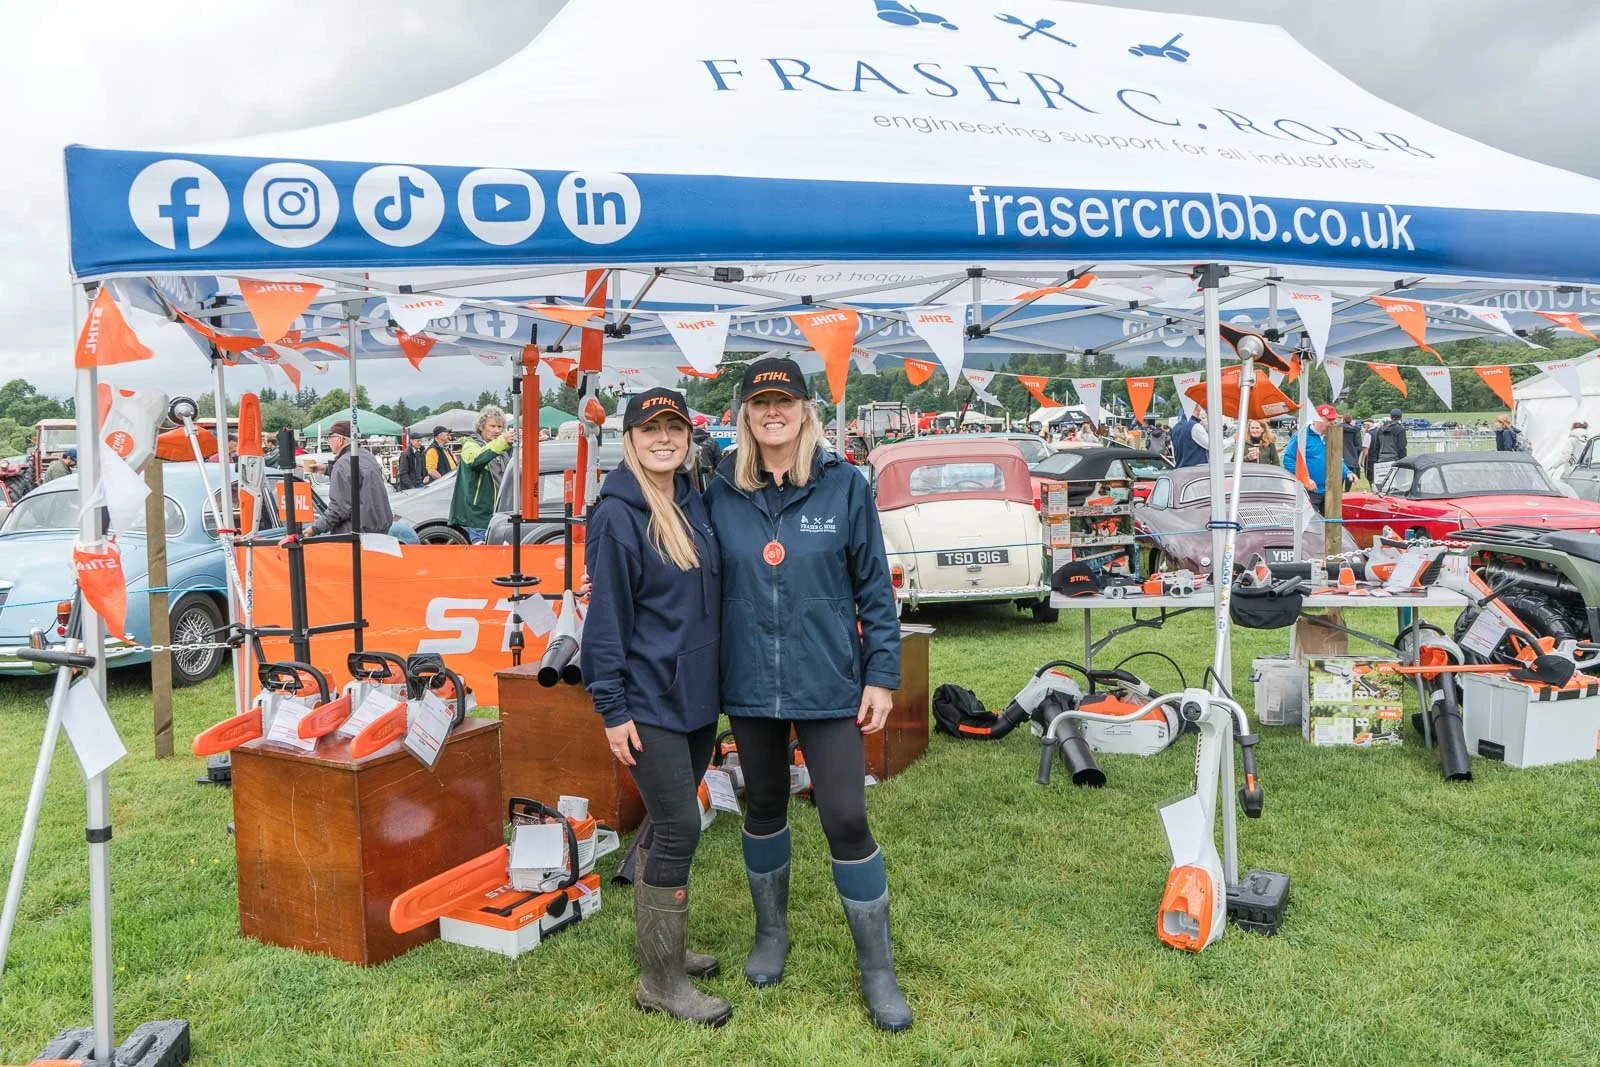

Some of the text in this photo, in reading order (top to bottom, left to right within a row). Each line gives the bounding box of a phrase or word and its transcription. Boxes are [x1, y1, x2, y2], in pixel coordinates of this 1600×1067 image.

[697, 57, 1101, 114] FRASER
[1213, 107, 1435, 159] ROBB
[873, 112, 1375, 170] engineering support for all industries
[968, 185, 1416, 252] frasercrobb.co.uk
[752, 371, 791, 384] STIHL
[641, 397, 679, 410] STIHL
[281, 495, 309, 511] SHL
[946, 552, 1000, 565] TSD 816
[1069, 575, 1091, 583] STIHL
